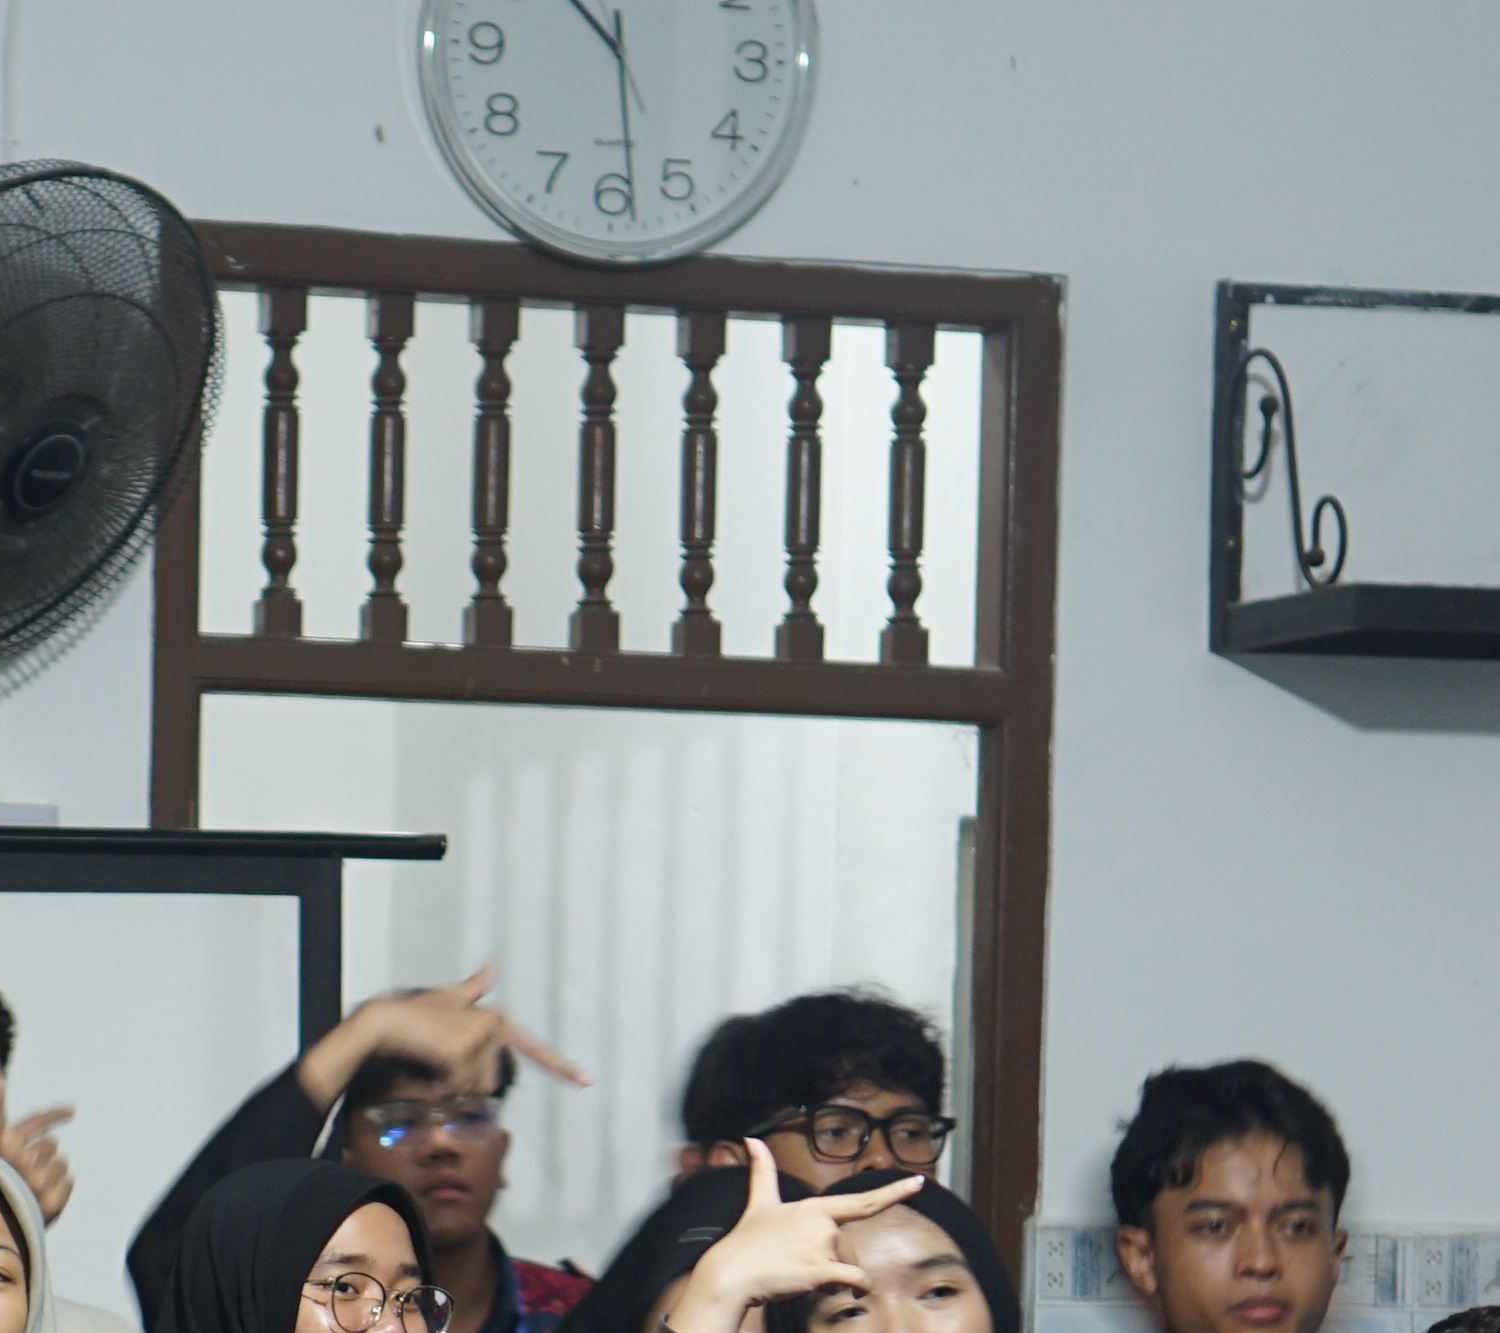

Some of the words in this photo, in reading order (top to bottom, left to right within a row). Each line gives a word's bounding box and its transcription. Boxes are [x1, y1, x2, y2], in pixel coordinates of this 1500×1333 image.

[468, 21, 504, 65] 9
[733, 39, 769, 83] 3
[484, 93, 520, 136] 8
[711, 108, 744, 151] 4
[536, 150, 569, 194] 7
[660, 159, 694, 200] 5
[594, 173, 631, 216] 6
